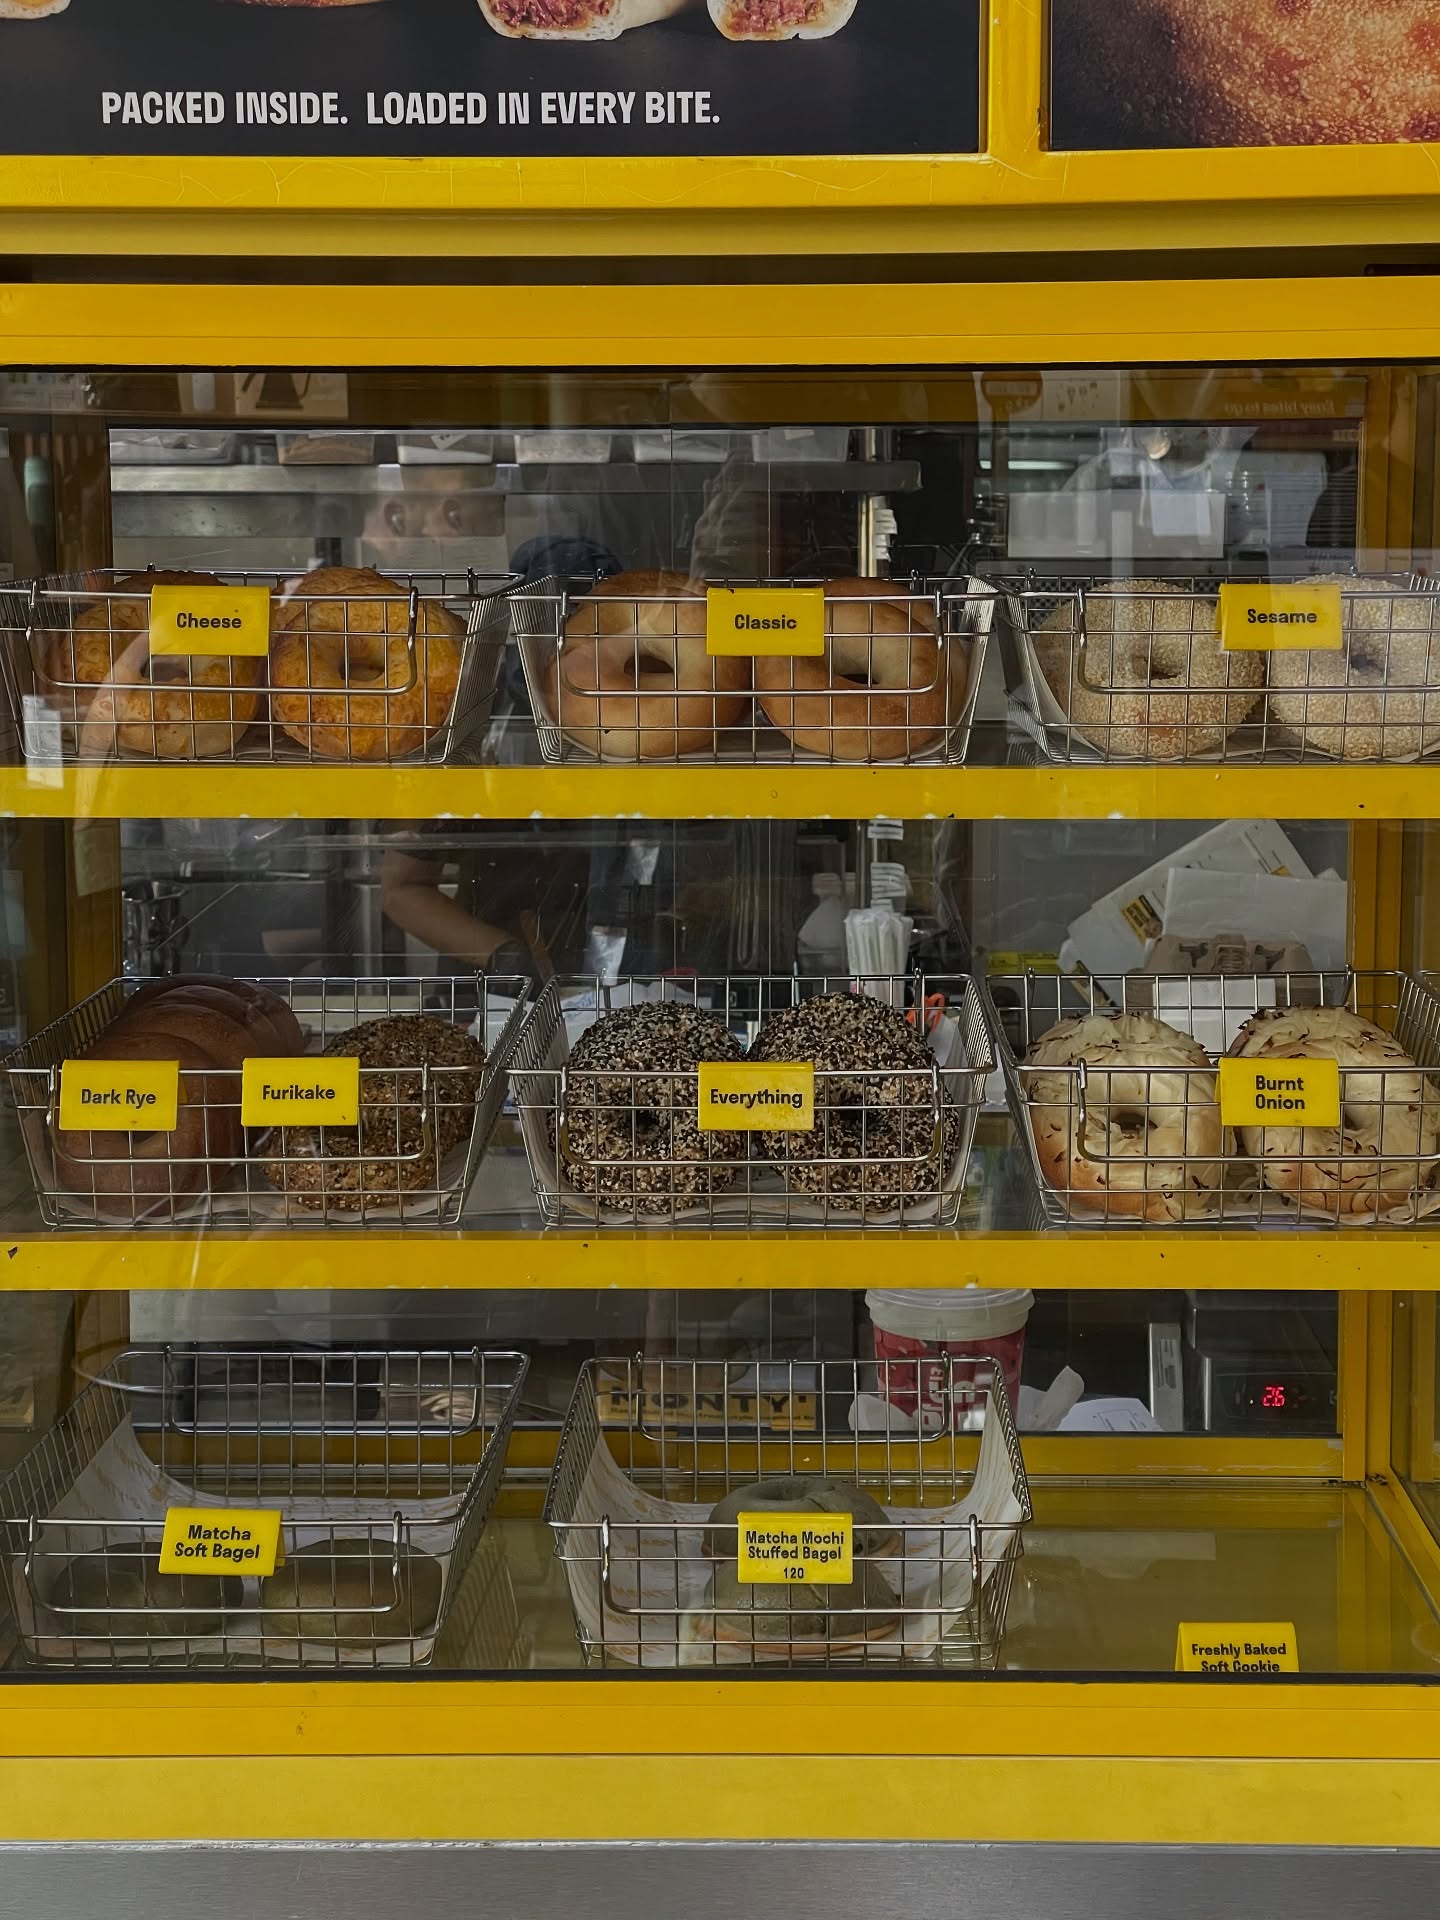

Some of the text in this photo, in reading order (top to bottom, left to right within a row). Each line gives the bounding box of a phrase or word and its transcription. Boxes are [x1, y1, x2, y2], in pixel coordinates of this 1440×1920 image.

[101, 91, 720, 125] PACKED INSIDE. LOADED IN EVERY BITE.
[176, 612, 242, 629] Cheese
[734, 613, 797, 630] Classic
[1247, 608, 1318, 624] Sesame
[1255, 1074, 1304, 1091] Burnt
[81, 1088, 157, 1110] Dark Rye
[262, 1084, 336, 1100] Furikake
[710, 1088, 803, 1109] Everything
[1255, 1093, 1306, 1110] Onion
[187, 1524, 252, 1541] Matcha
[745, 1530, 844, 1545] Matcha Mochi
[174, 1541, 260, 1563] Soft Bagel
[748, 1545, 842, 1563] Stuffed Bagel
[783, 1567, 804, 1580] 120
[1191, 1643, 1287, 1660] Freshly Baked
[1201, 1660, 1281, 1672] Soft Cookie
